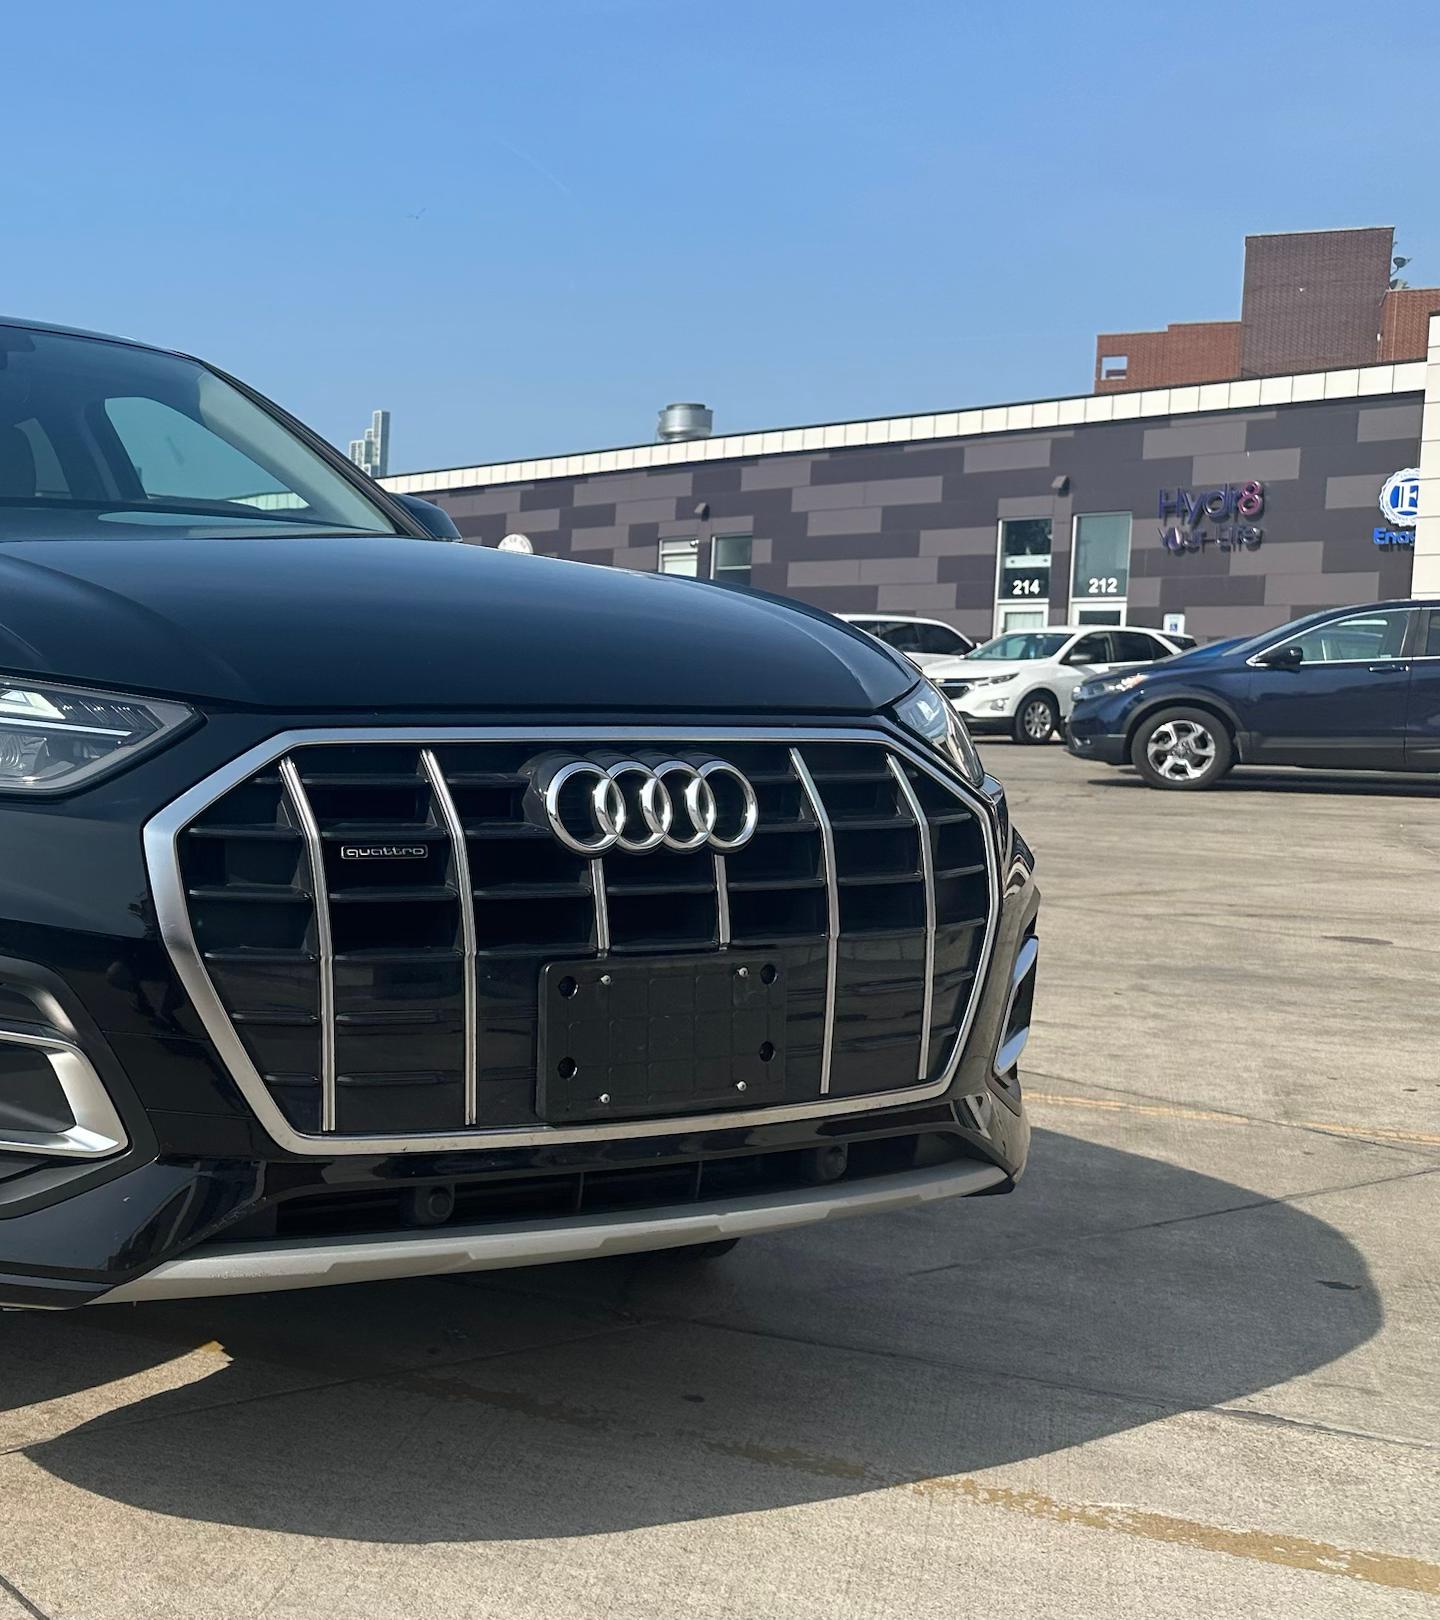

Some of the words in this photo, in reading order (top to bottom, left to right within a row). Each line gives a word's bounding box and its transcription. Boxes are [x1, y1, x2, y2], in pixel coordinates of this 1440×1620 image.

[1157, 480, 1262, 525] Hydr8
[1012, 579, 1040, 595] 214
[1088, 577, 1118, 594] 212
[345, 846, 425, 858] quattro
